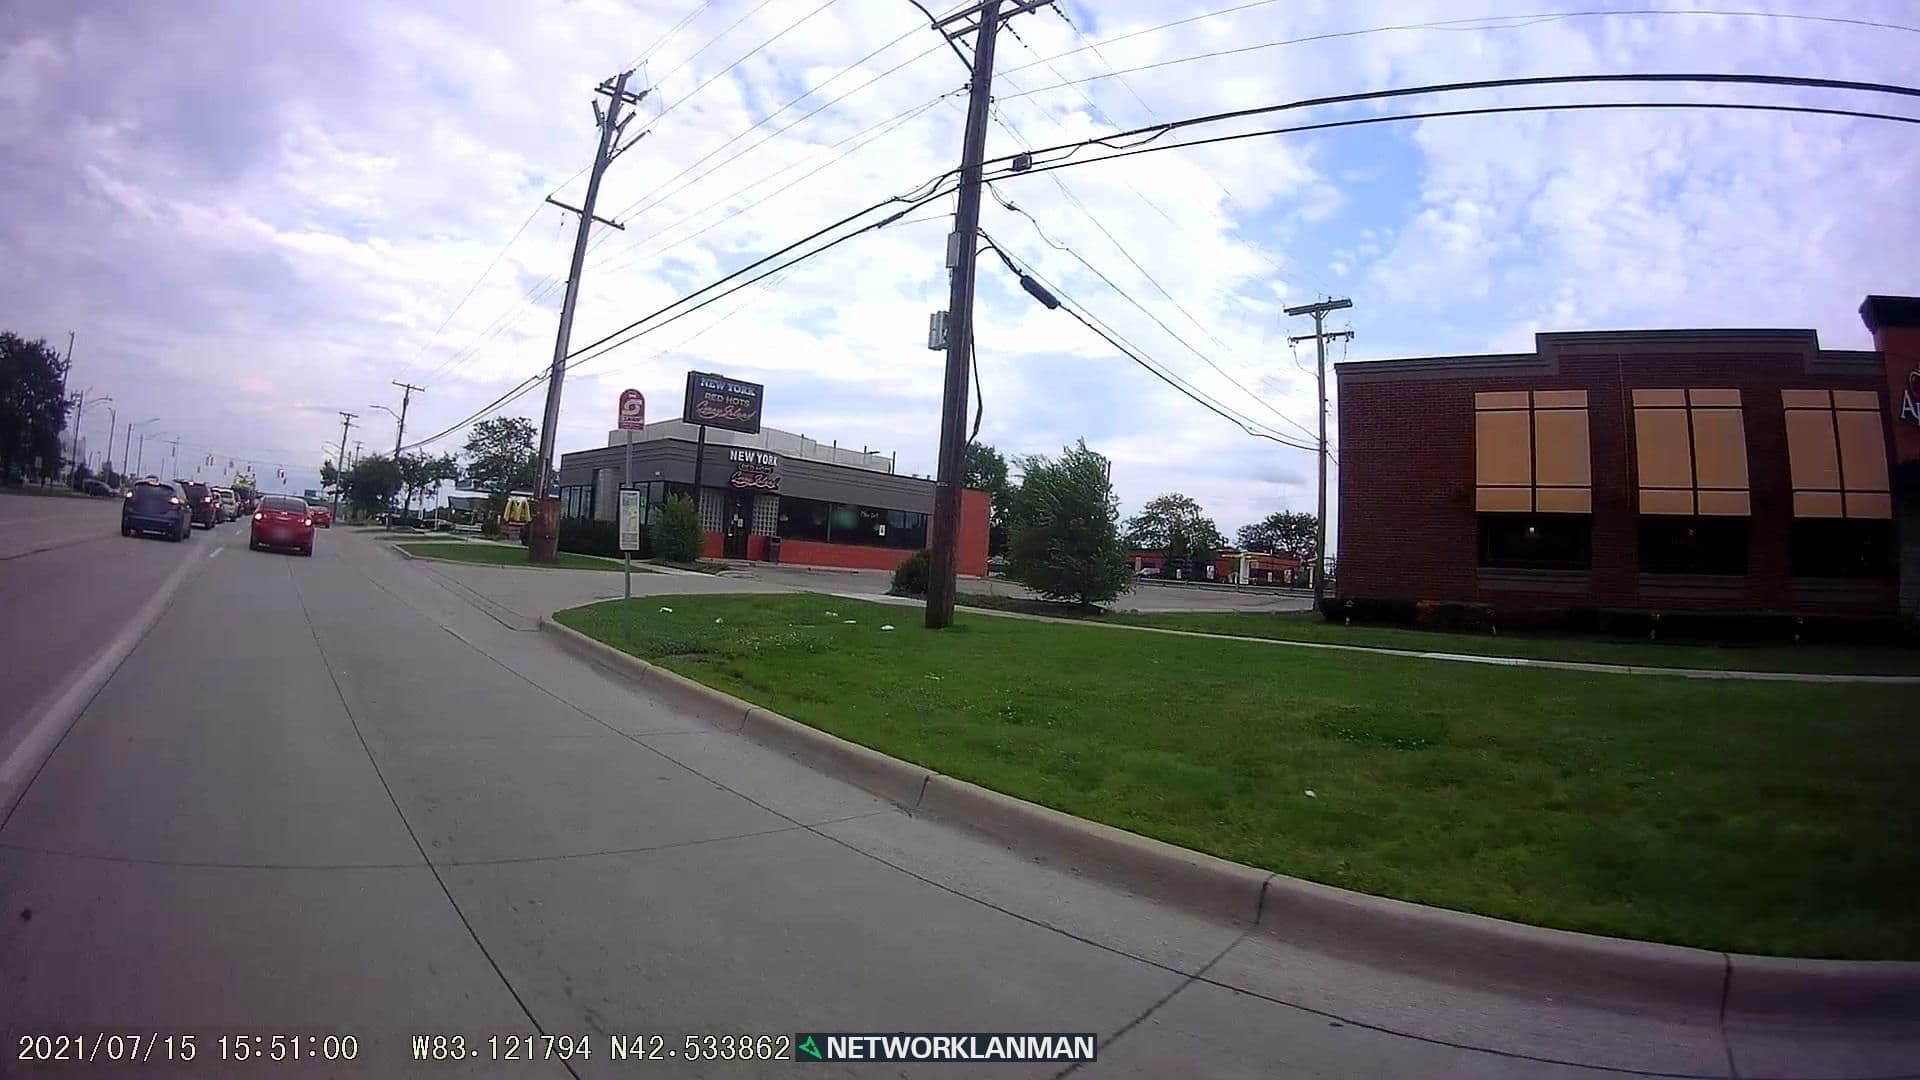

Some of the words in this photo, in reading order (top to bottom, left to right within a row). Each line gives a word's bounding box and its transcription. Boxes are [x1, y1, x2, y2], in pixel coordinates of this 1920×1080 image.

[700, 377, 725, 390] NEW
[727, 383, 757, 397] YORK
[704, 392, 724, 402] RED
[726, 395, 751, 407] HOTS
[730, 449, 755, 462] NEW
[756, 452, 778, 466] YORK
